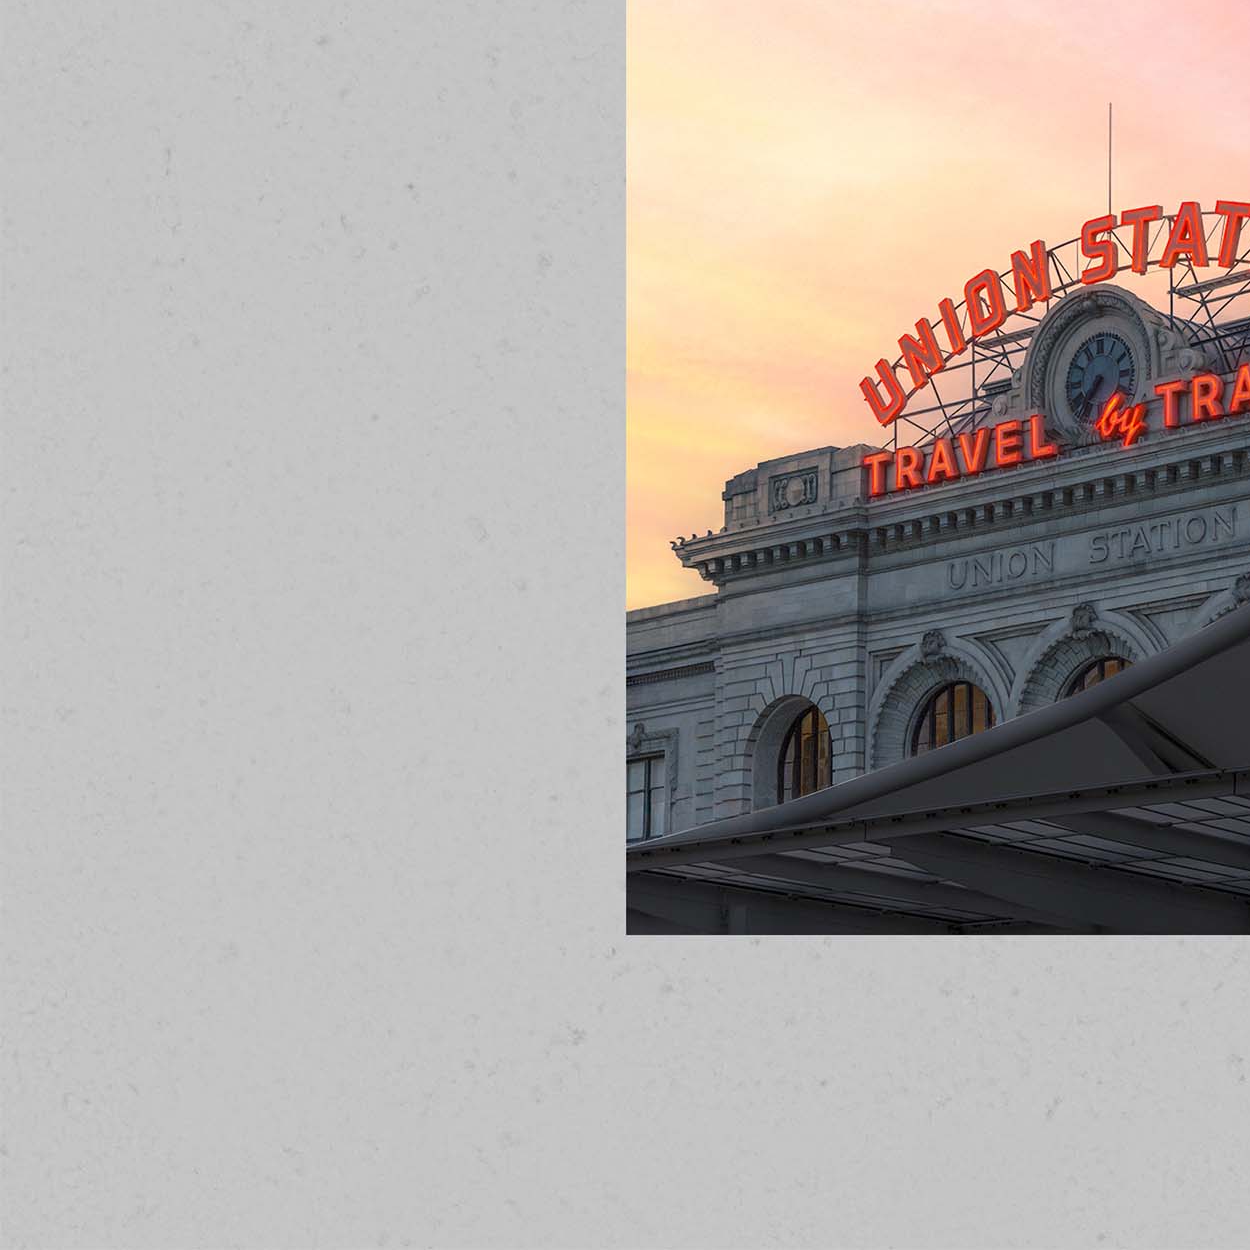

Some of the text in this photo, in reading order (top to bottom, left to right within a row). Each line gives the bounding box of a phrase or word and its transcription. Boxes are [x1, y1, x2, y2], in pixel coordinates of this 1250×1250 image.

[860, 240, 1052, 426] UNION
[863, 414, 1059, 496] TRAVEL
[1096, 391, 1147, 446] by
[949, 508, 1238, 590] UNION STATION
